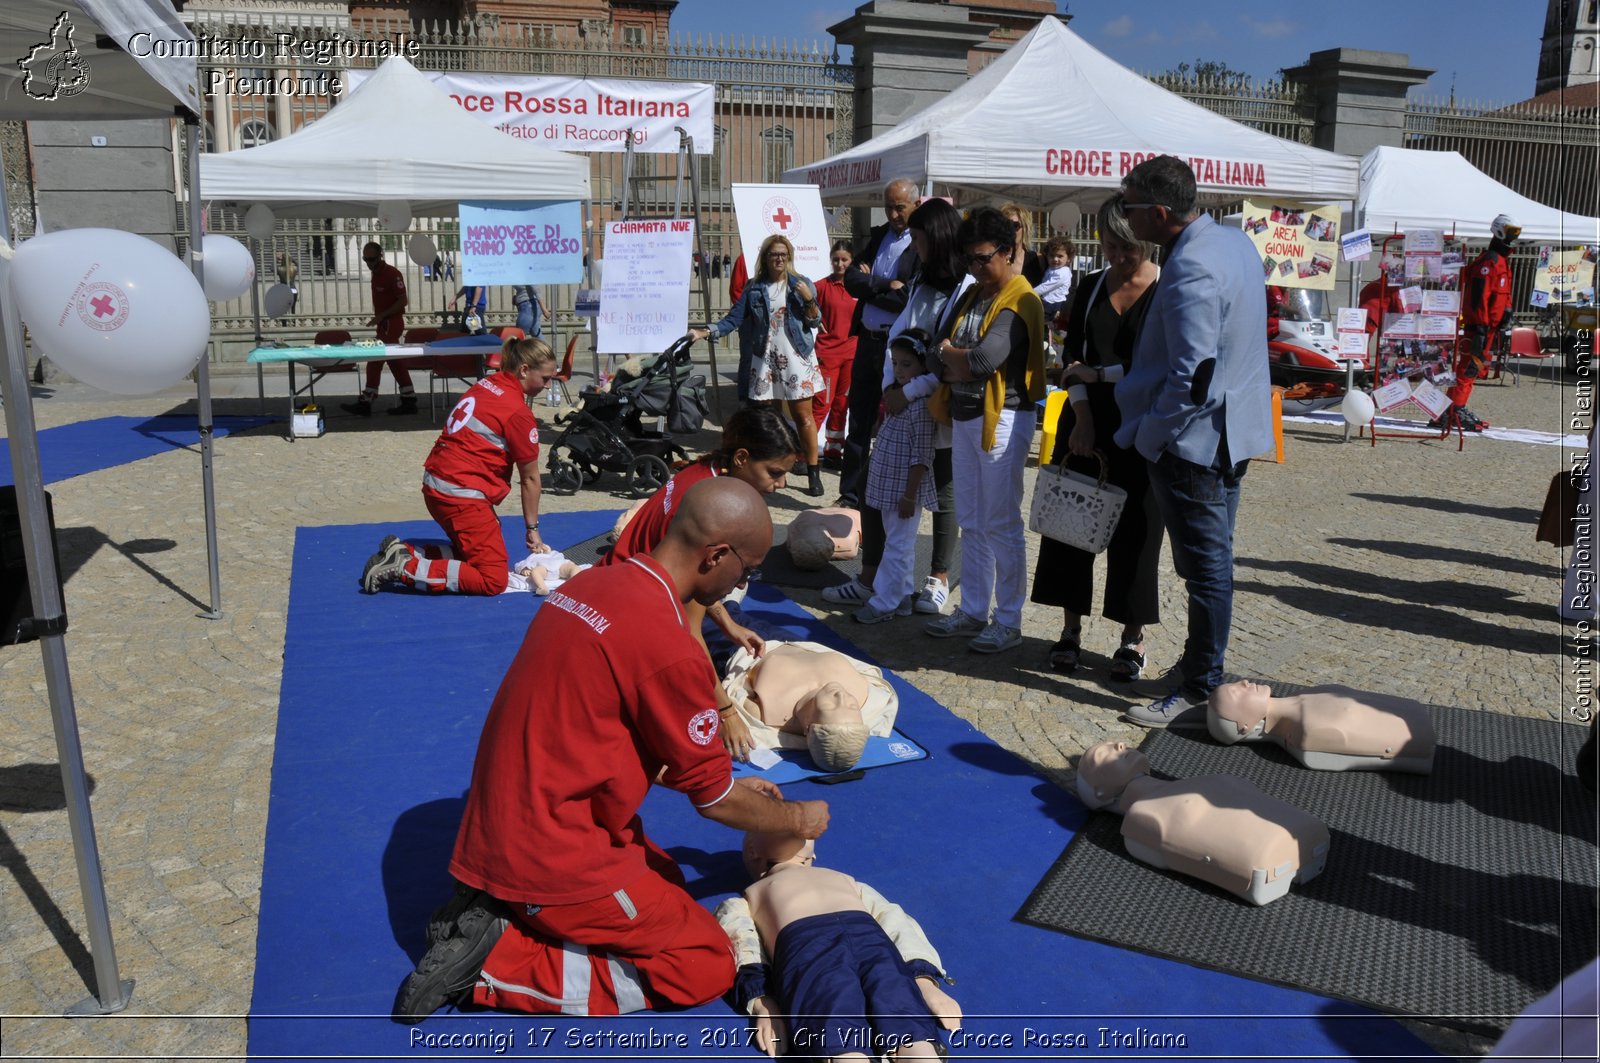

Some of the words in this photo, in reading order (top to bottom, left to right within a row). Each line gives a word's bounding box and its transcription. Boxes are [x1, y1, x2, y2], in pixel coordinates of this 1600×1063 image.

[505, 91, 588, 114] Rossa
[598, 94, 690, 118] Italiana
[494, 123, 538, 139] itato
[544, 124, 558, 139] di
[565, 124, 648, 144] Raccongi
[828, 163, 849, 188] ROSSA
[849, 158, 882, 185] ITALIANA
[1046, 148, 1112, 177] CROCE
[1188, 157, 1267, 187] ITALIANA
[467, 225, 536, 240] MANOVRE
[544, 224, 560, 239] DI
[612, 222, 666, 234] CHIAMATA
[671, 221, 690, 232] NUE
[1273, 227, 1297, 241] AREA
[464, 240, 505, 256] PRIMO
[512, 238, 579, 254] SOCCORSO
[1265, 242, 1304, 258] GIOVANI
[71, 281, 86, 300] Rossa
[58, 301, 74, 327] Italiana
[572, 602, 612, 635] ITALIANA
